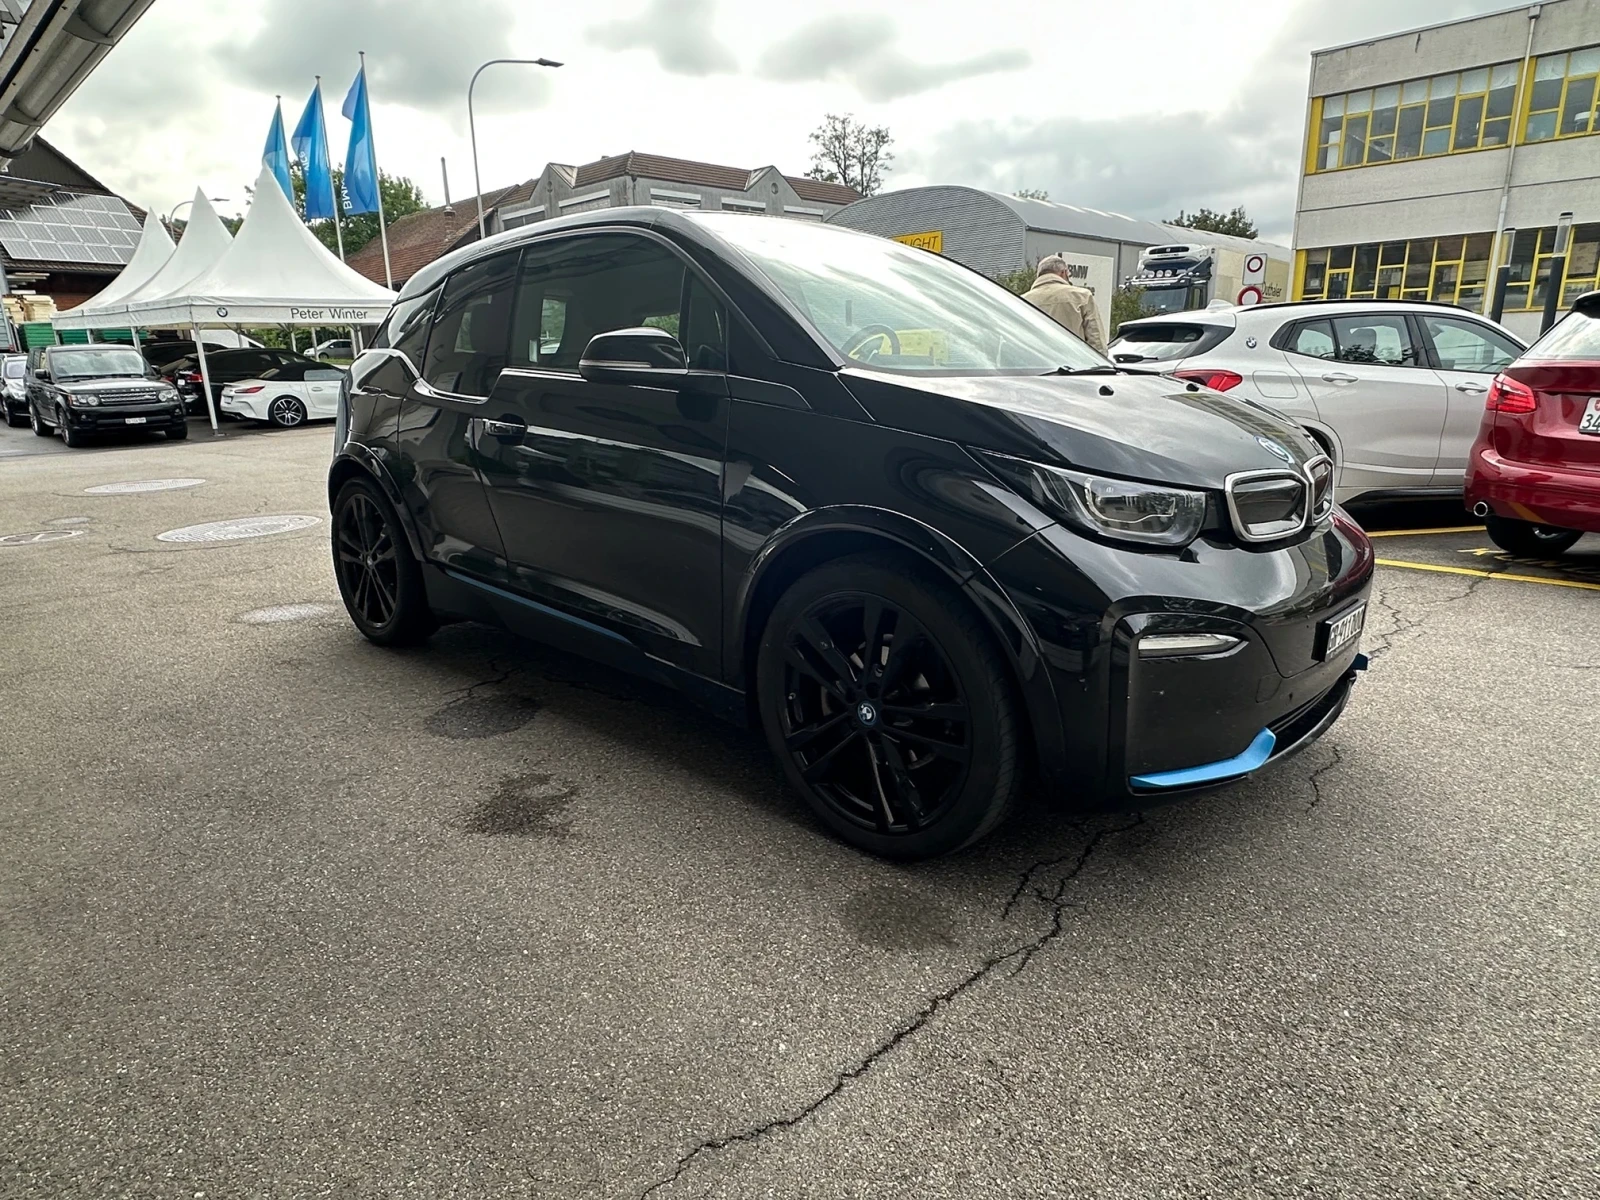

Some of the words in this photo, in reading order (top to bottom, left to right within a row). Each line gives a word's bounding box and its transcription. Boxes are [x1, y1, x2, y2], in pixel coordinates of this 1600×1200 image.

[1067, 263, 1089, 279] BMW
[290, 307, 324, 320] Peter
[328, 307, 368, 320] Winter
